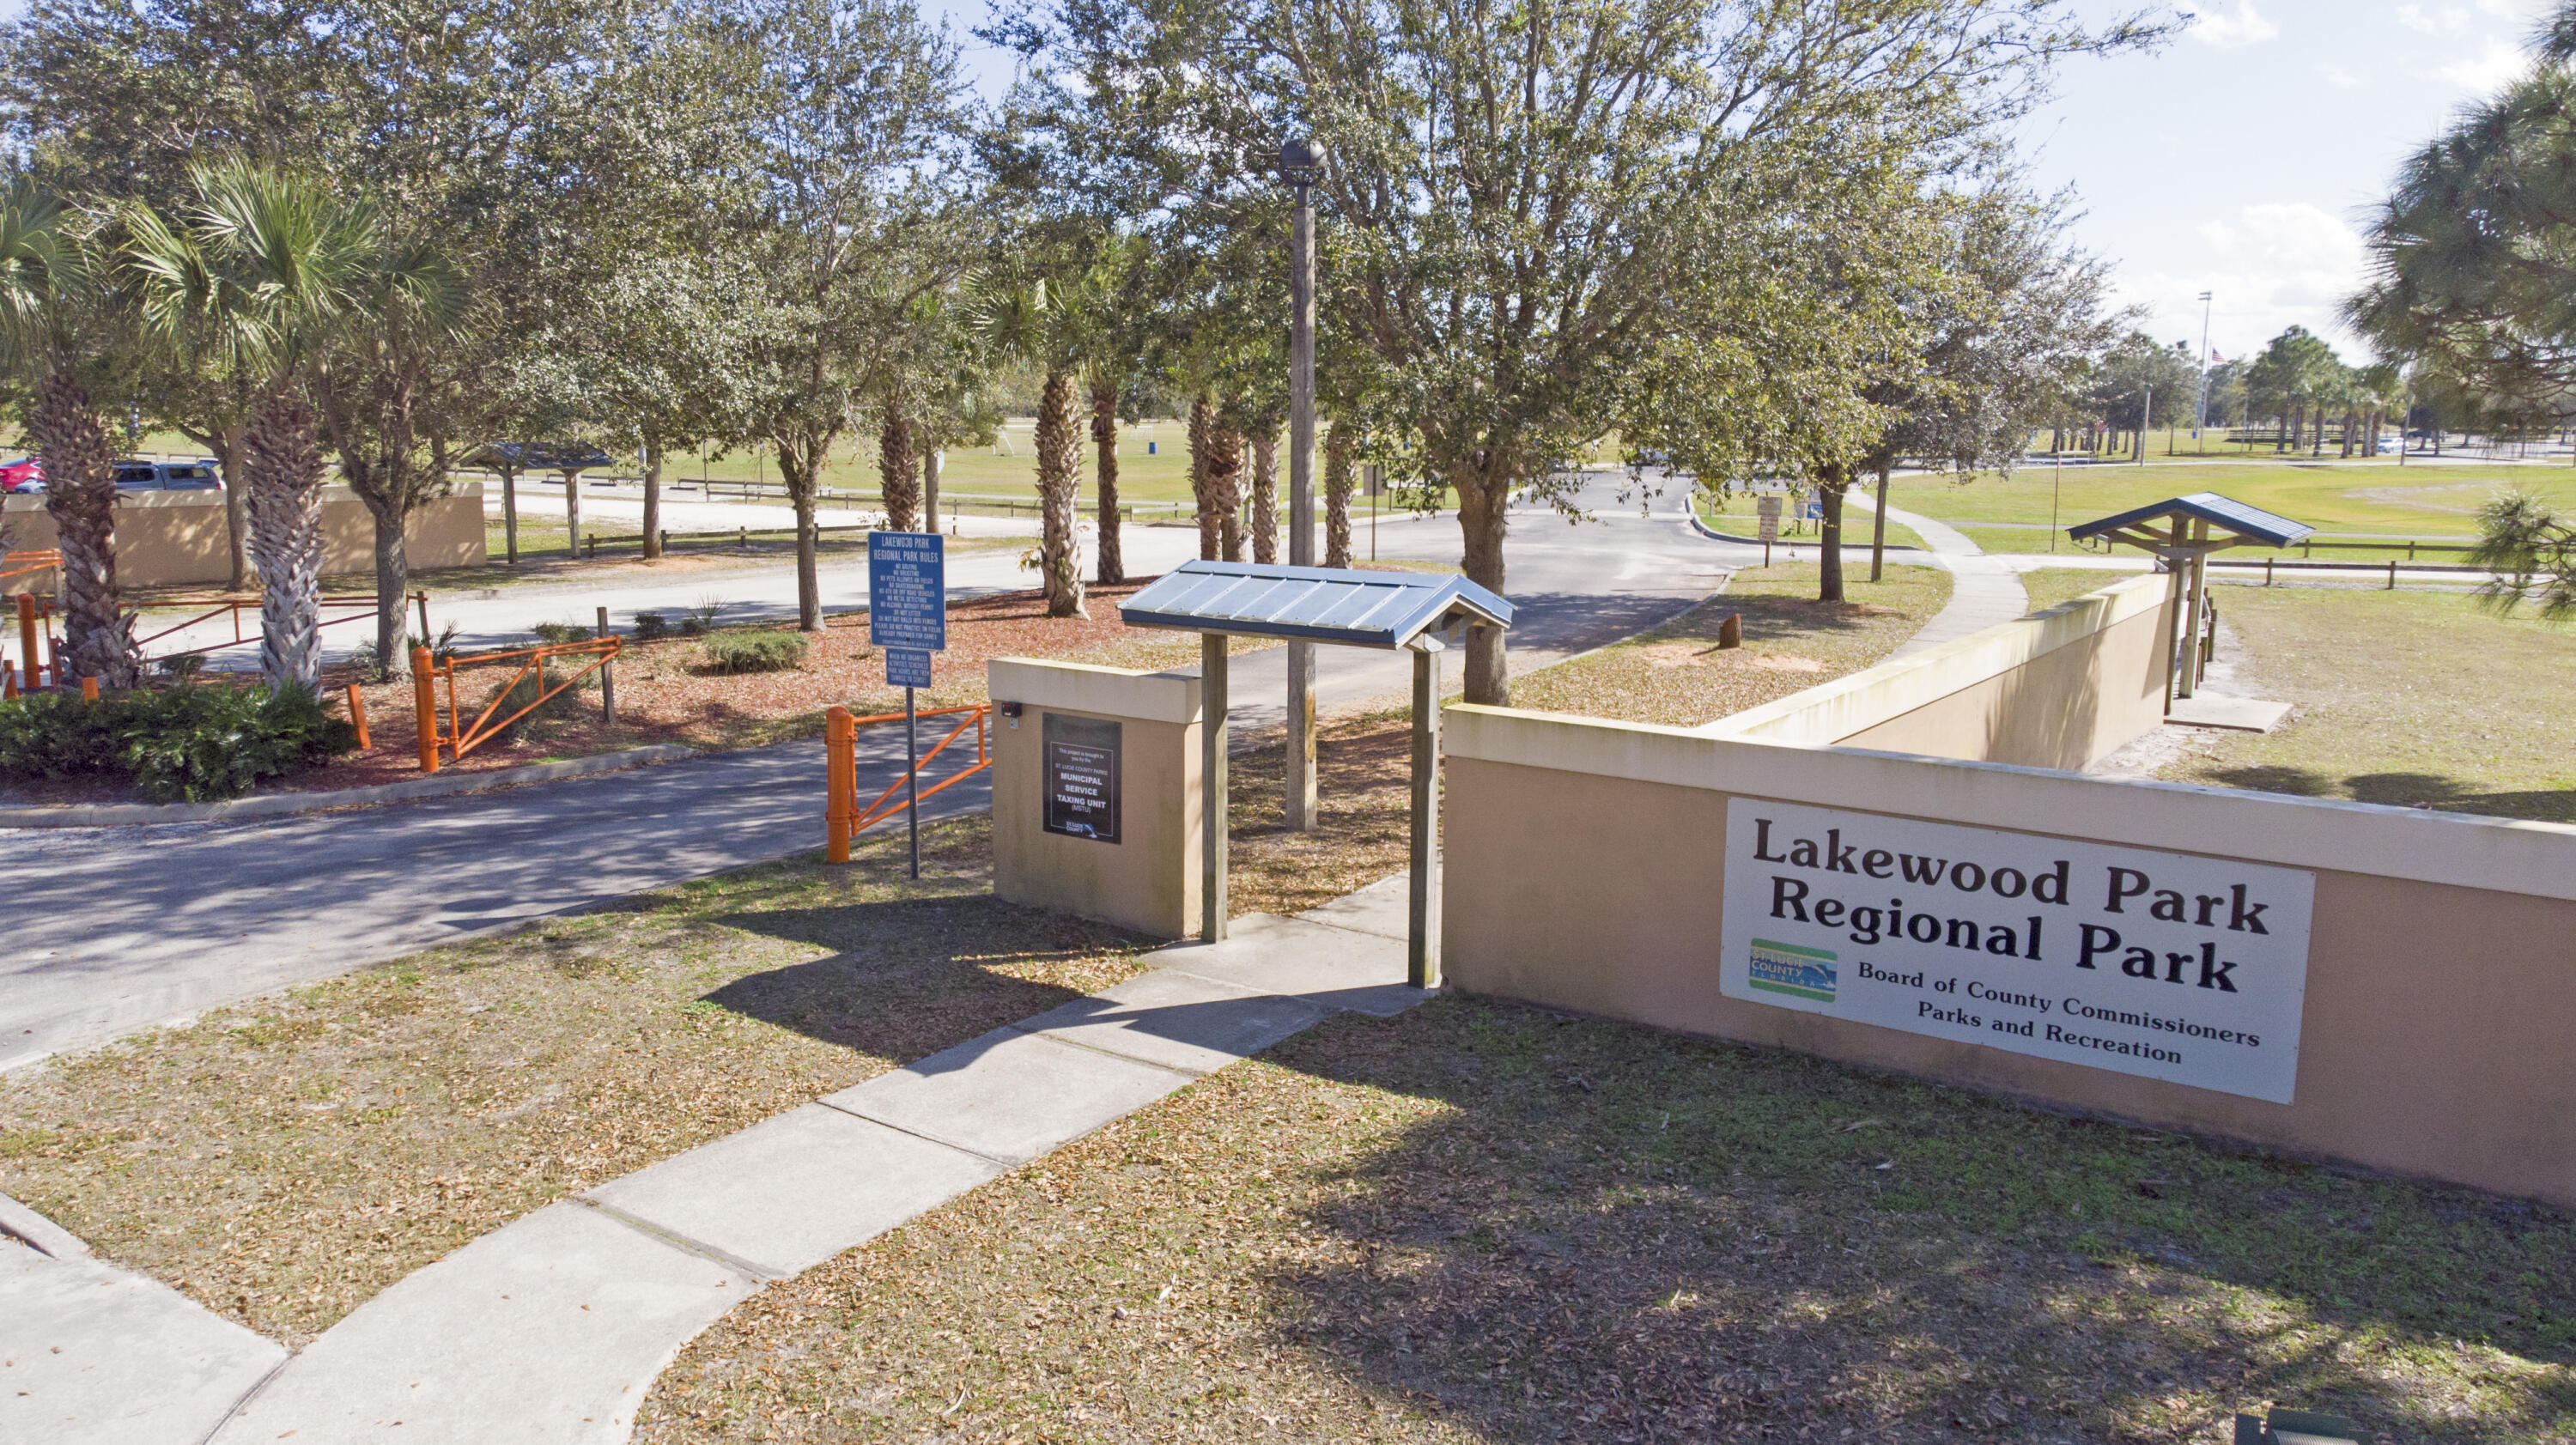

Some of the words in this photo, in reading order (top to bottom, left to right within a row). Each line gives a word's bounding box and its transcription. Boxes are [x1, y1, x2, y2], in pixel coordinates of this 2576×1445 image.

[882, 537, 913, 548] LAKEWOOD
[915, 537, 929, 548] PARK
[874, 549, 902, 561] REGIONAL
[903, 550, 918, 562] PARK
[920, 552, 938, 563] RULES
[1060, 773, 1103, 786] MUNICIPAL
[1065, 785, 1097, 796] SERVICE
[1057, 794, 1085, 805] TAXING
[1087, 798, 1106, 809] UNIT
[1753, 818, 2069, 906] Lakewood
[2104, 866, 2269, 935] Park
[1770, 876, 2042, 961] Regional
[2075, 923, 2238, 993] Park
[1752, 960, 1803, 977] COUNTY
[1858, 961, 1924, 988] Board
[1934, 978, 1958, 993] of
[1967, 981, 2052, 1013] County
[2063, 998, 2261, 1047] Commissioners
[1917, 1000, 1982, 1028] Parks
[1991, 1021, 2033, 1037] and
[2045, 1023, 2182, 1064] Recreation
